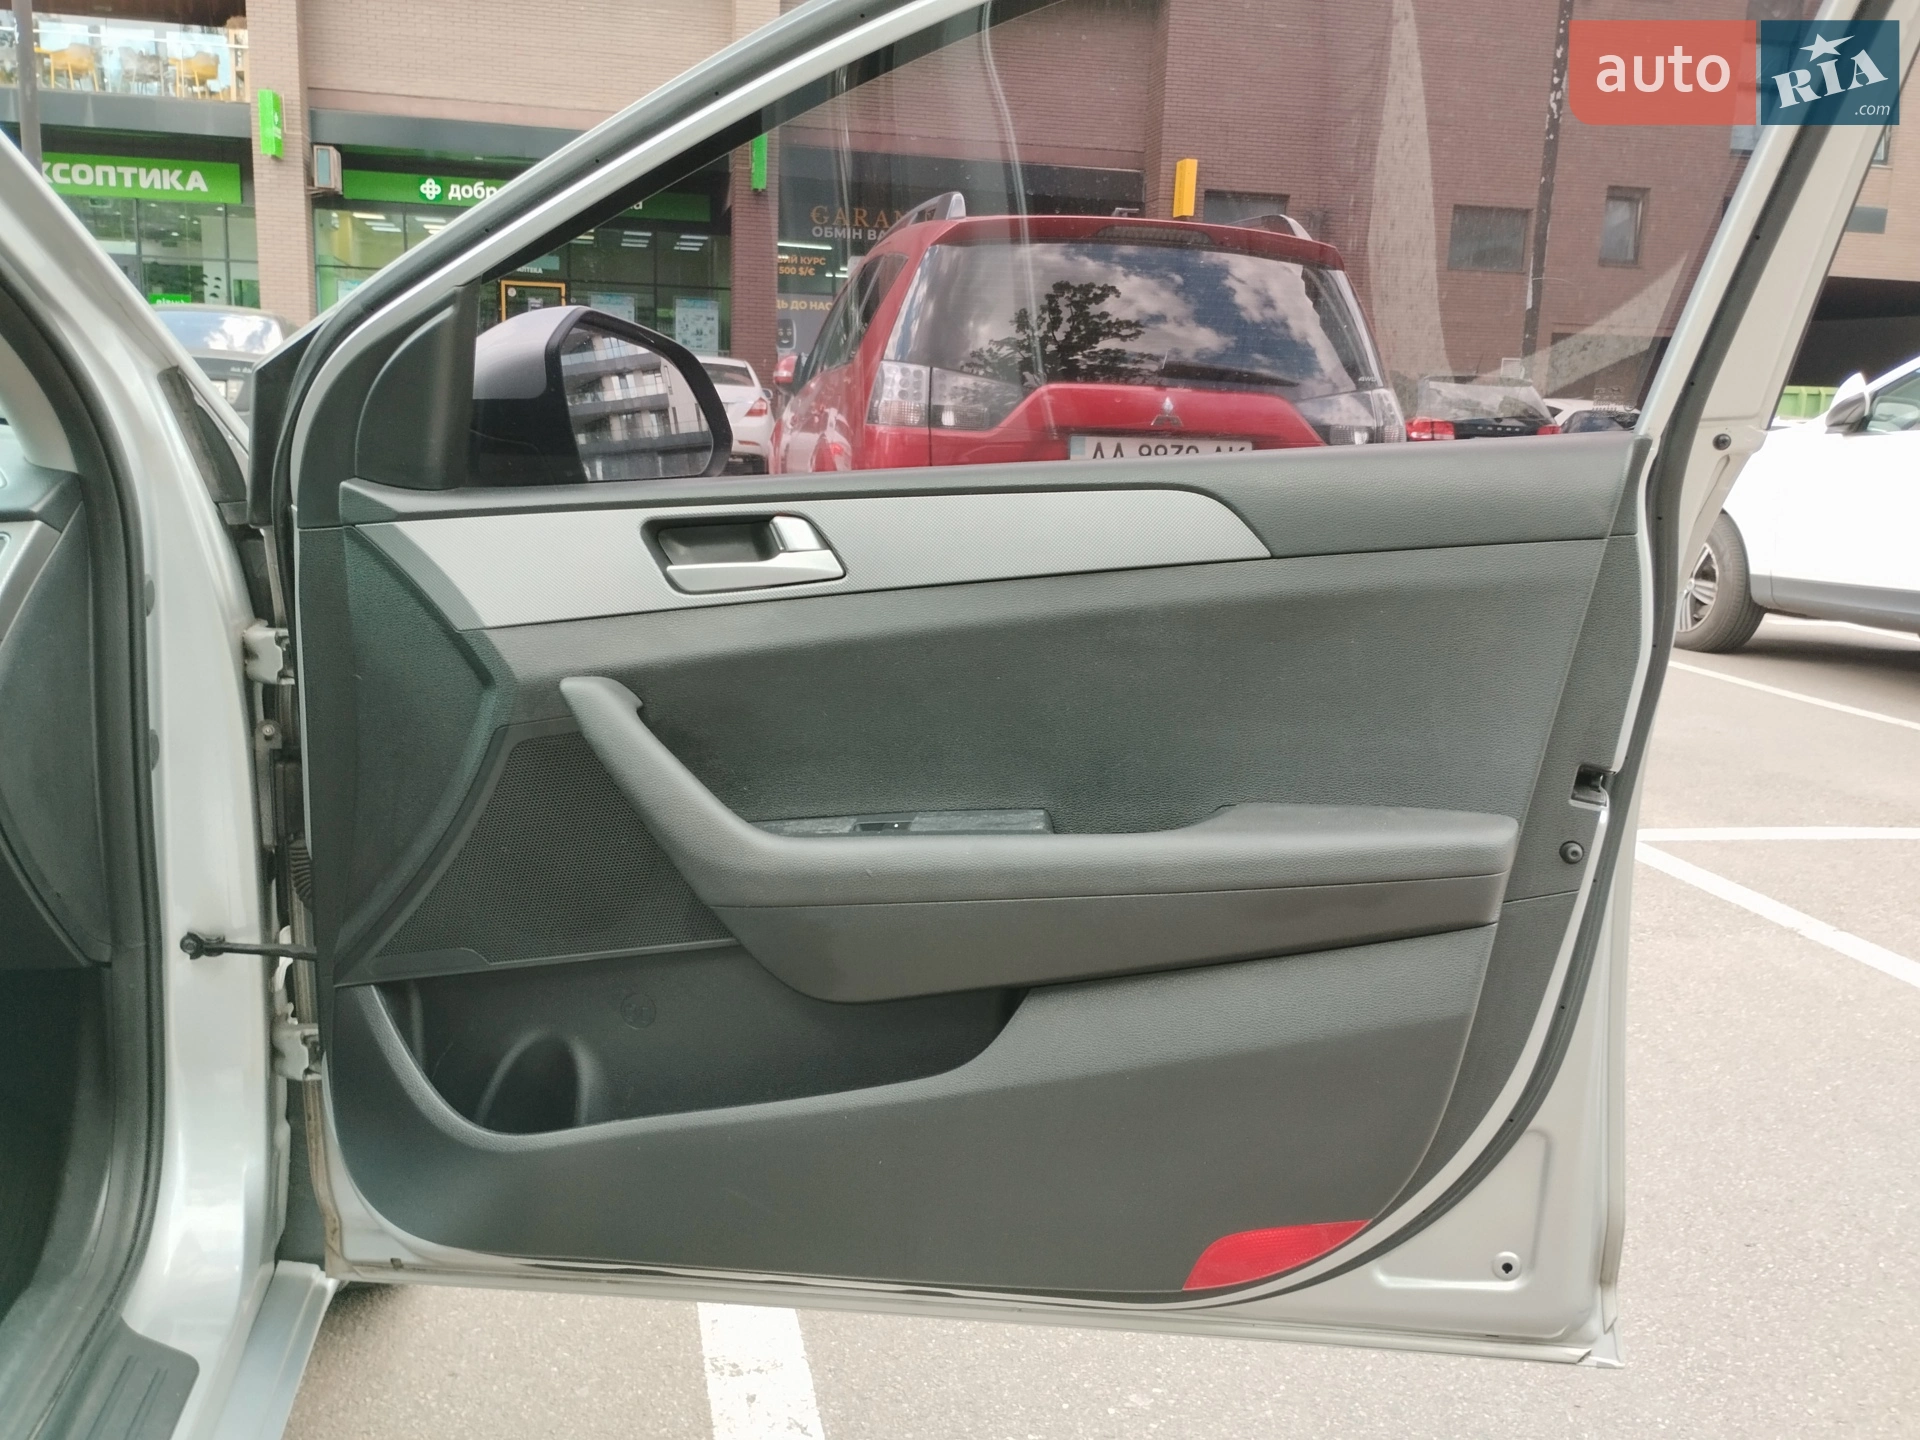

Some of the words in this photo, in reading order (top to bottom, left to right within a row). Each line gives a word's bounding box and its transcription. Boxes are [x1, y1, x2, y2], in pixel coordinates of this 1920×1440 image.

[812, 226, 863, 240] ОБМІН
[800, 255, 827, 266] КУРС
[790, 300, 808, 310] ДО
[809, 301, 833, 311] НАС
